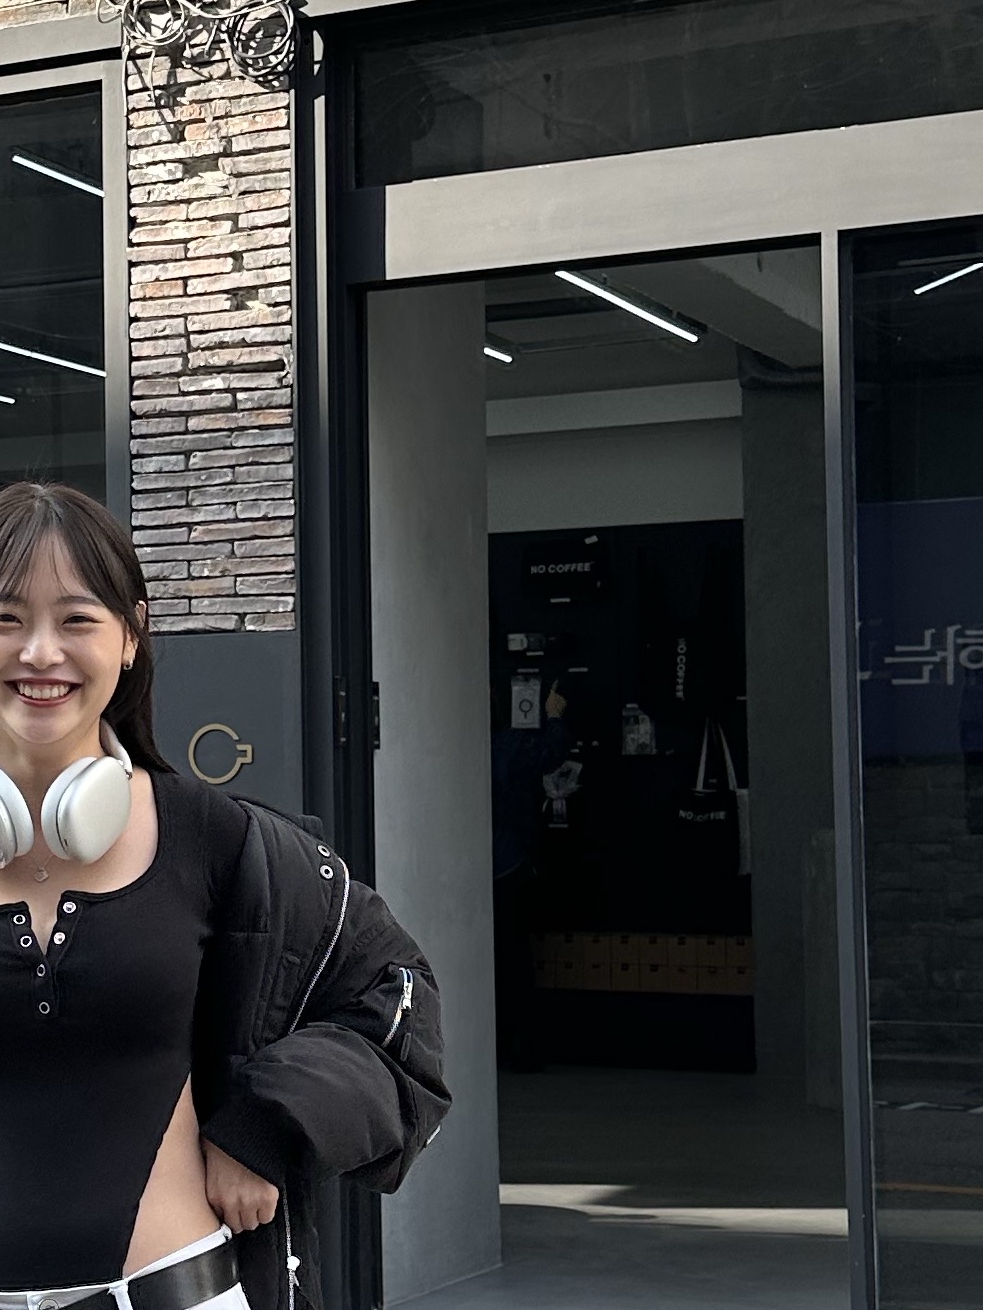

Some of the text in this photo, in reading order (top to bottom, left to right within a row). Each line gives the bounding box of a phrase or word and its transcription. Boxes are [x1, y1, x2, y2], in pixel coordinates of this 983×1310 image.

[531, 562, 591, 574] NO COFFEE
[679, 809, 693, 820] NO
